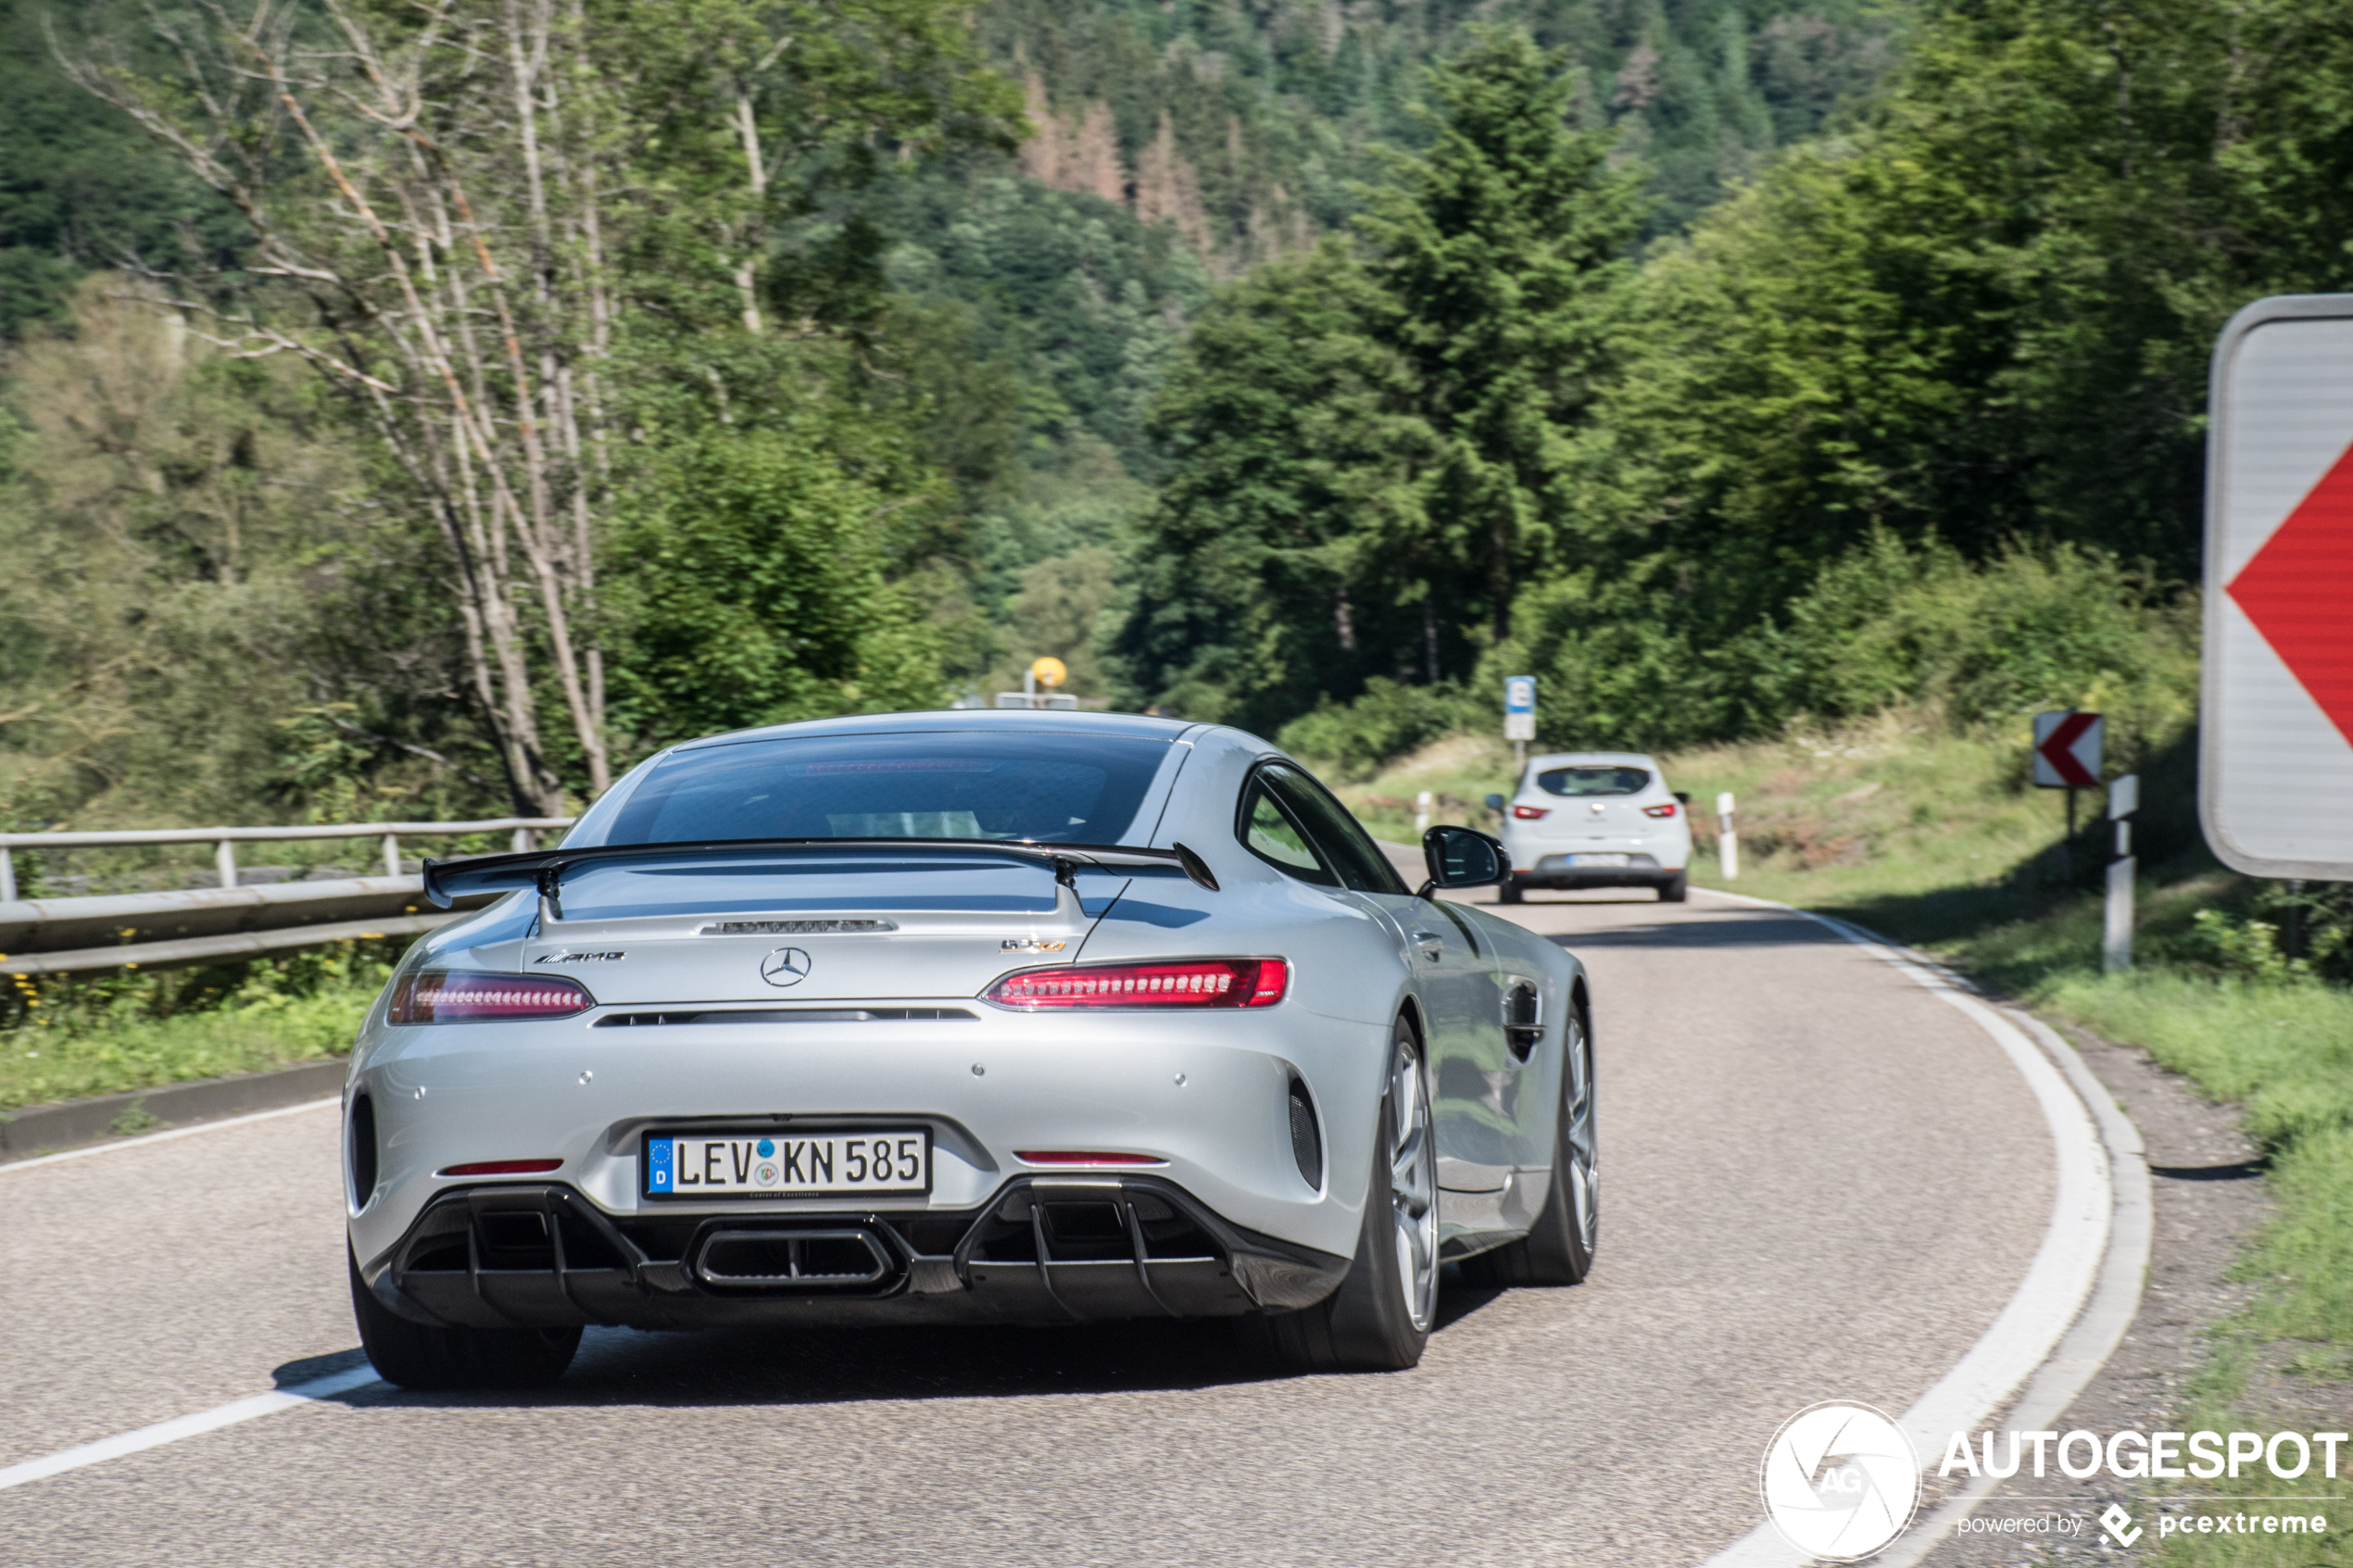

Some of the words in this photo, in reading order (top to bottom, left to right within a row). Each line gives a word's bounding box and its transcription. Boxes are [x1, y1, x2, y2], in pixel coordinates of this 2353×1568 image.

[561, 951, 626, 962] AMG
[678, 1141, 753, 1185] LEV
[784, 1139, 834, 1184] KN
[846, 1138, 920, 1183] 585
[656, 1171, 666, 1185] D
